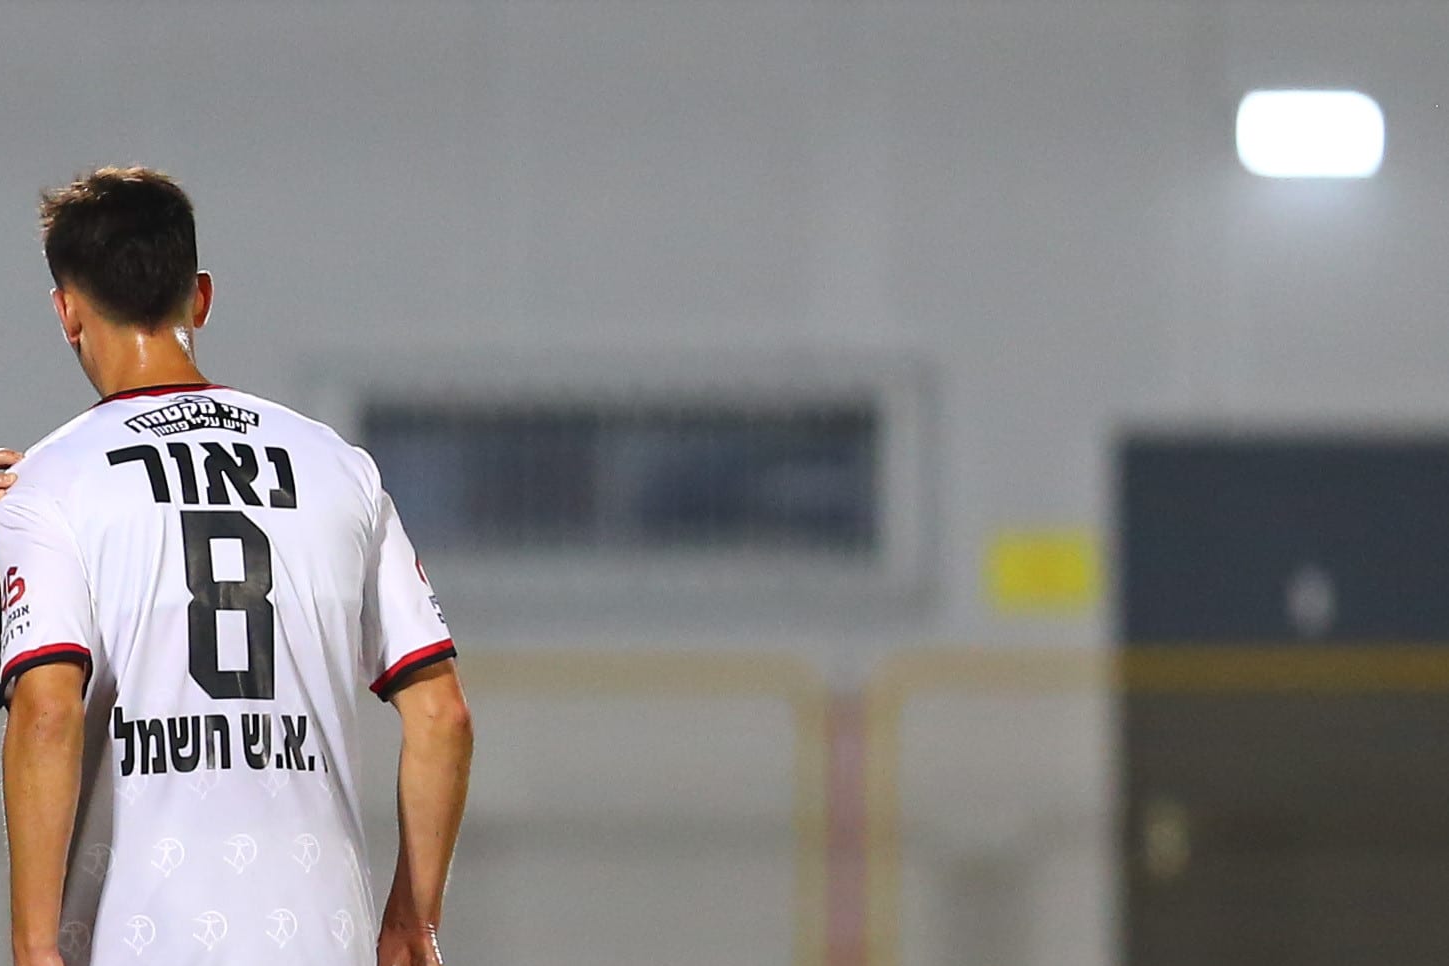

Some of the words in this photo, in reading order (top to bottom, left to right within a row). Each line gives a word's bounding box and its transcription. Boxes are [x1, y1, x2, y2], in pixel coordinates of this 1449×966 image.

[126, 401, 218, 434] מקטמון
[151, 420, 191, 438] פזמון
[220, 403, 256, 426] אני
[222, 418, 247, 434] ויש
[106, 442, 298, 510] נאור
[180, 510, 275, 700] 8
[113, 706, 232, 777] חשמל
